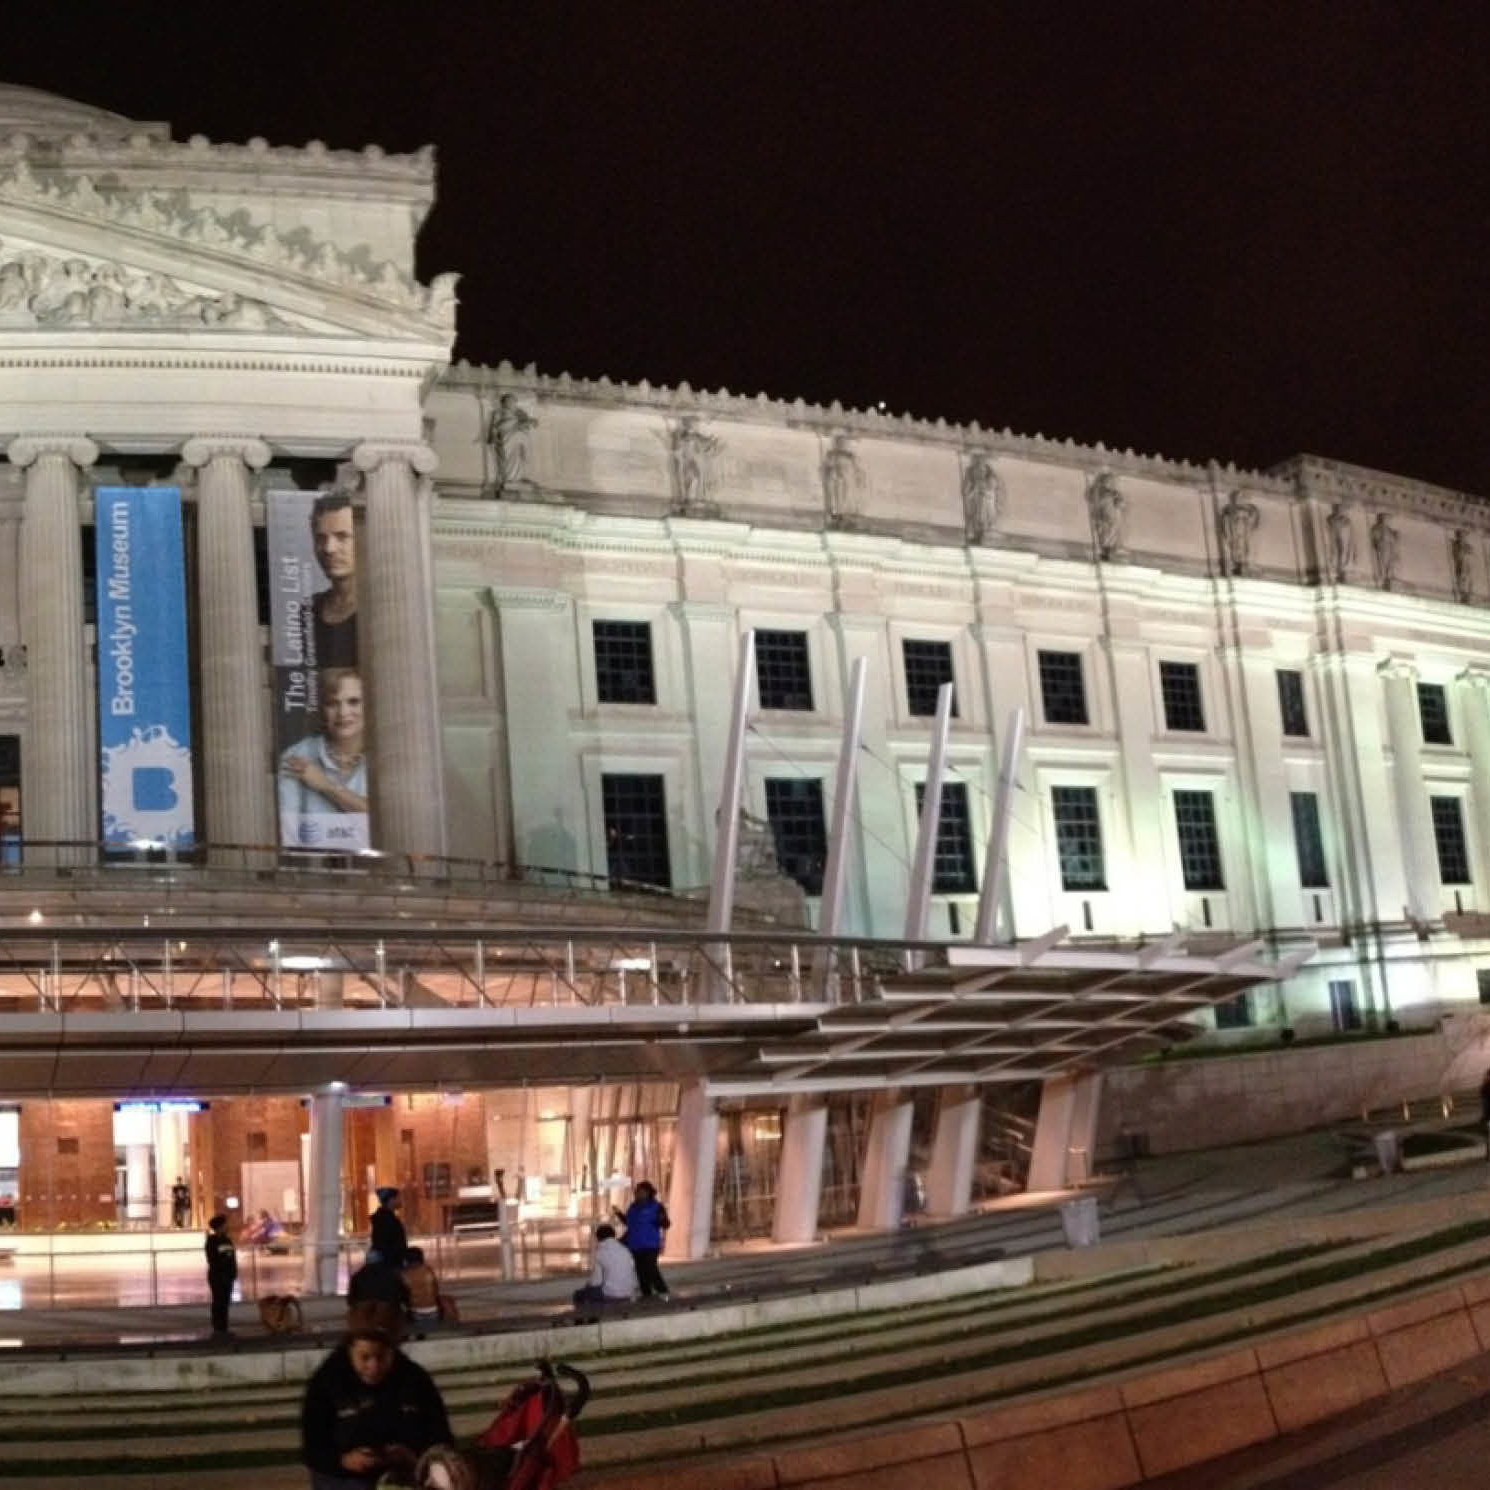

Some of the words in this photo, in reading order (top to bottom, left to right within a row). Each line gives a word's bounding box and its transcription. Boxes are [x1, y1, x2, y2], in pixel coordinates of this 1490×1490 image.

[108, 501, 132, 600] Museum
[280, 556, 301, 593] List
[284, 600, 303, 665] Latino
[110, 605, 137, 716] Brooklyn
[284, 671, 306, 712] The
[132, 767, 178, 811] B
